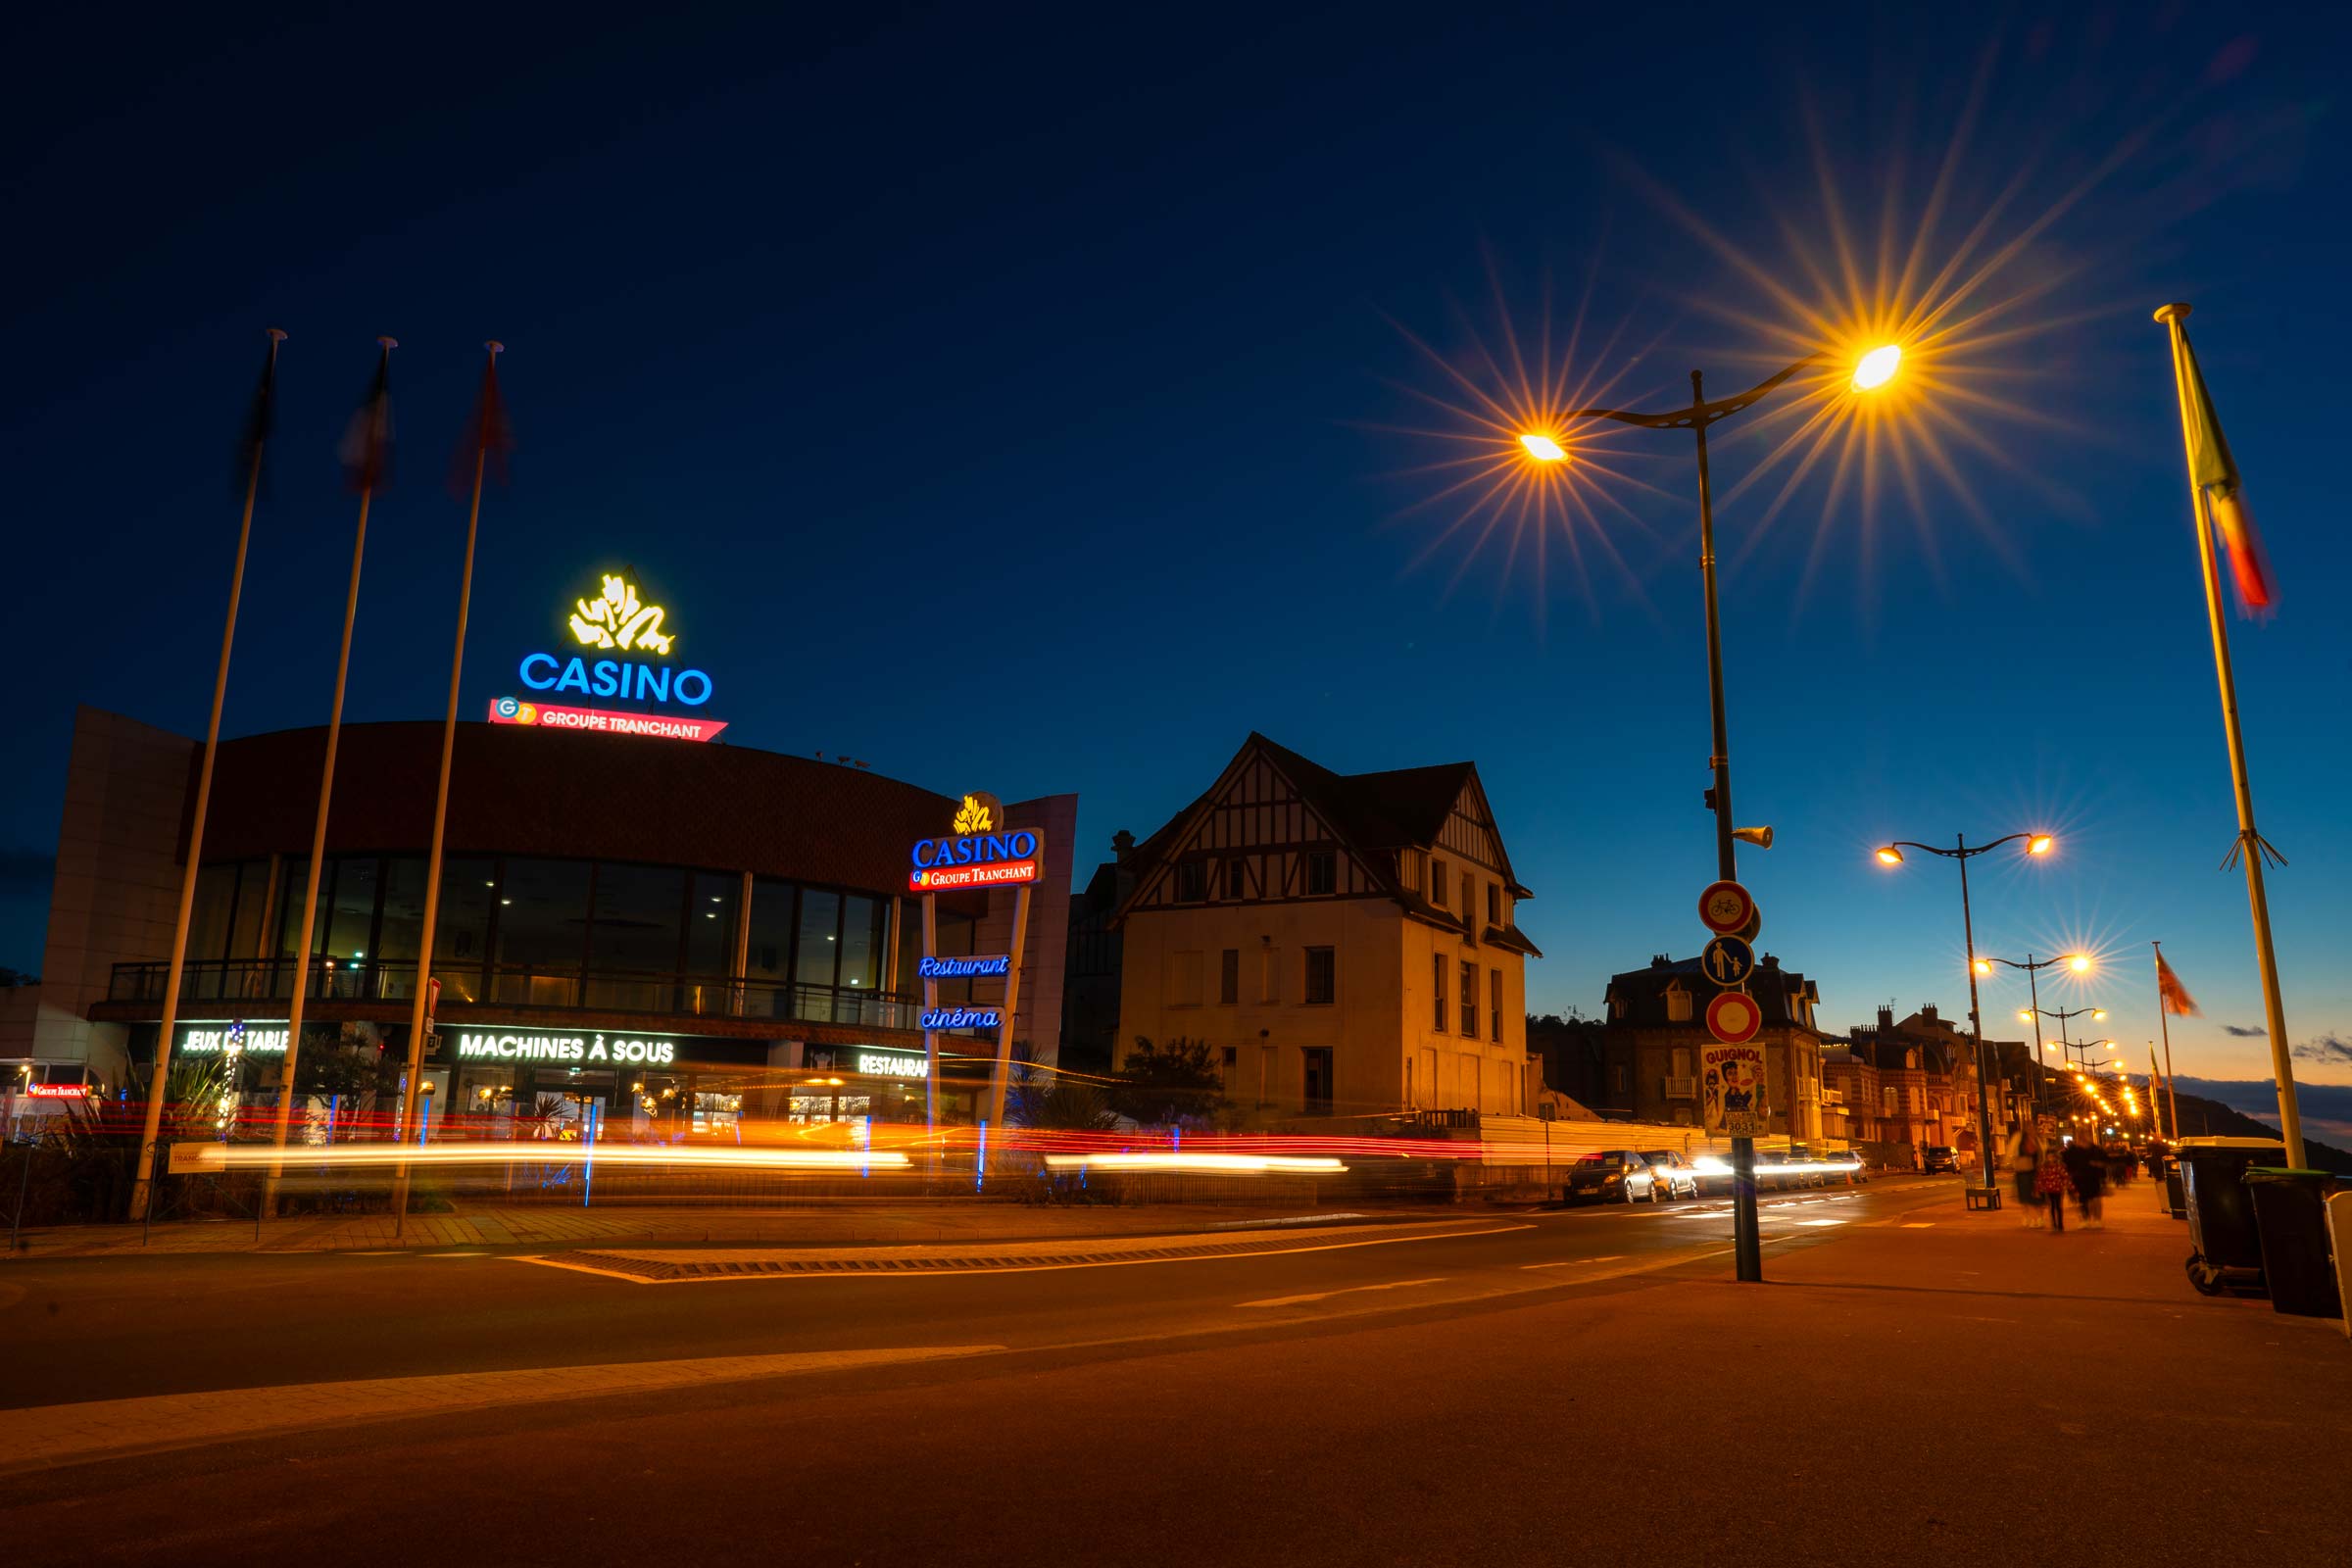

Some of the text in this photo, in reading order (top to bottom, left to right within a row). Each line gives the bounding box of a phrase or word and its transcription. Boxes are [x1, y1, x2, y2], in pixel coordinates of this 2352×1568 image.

[519, 654, 712, 706] CASINO
[542, 710, 607, 729] GROUPE
[610, 717, 702, 738] TRANCHANT
[911, 832, 1036, 868] CASINO
[930, 872, 971, 885] GROUPE
[971, 866, 1034, 882] TRANCHANT
[918, 956, 1008, 976] Restaurant
[921, 1007, 999, 1027] cinéma
[182, 1031, 222, 1051] JEUX
[246, 1031, 290, 1051] TABLE
[459, 1034, 674, 1063] MACHINES À SOUS
[1706, 1048, 1763, 1064] GUIGNOL
